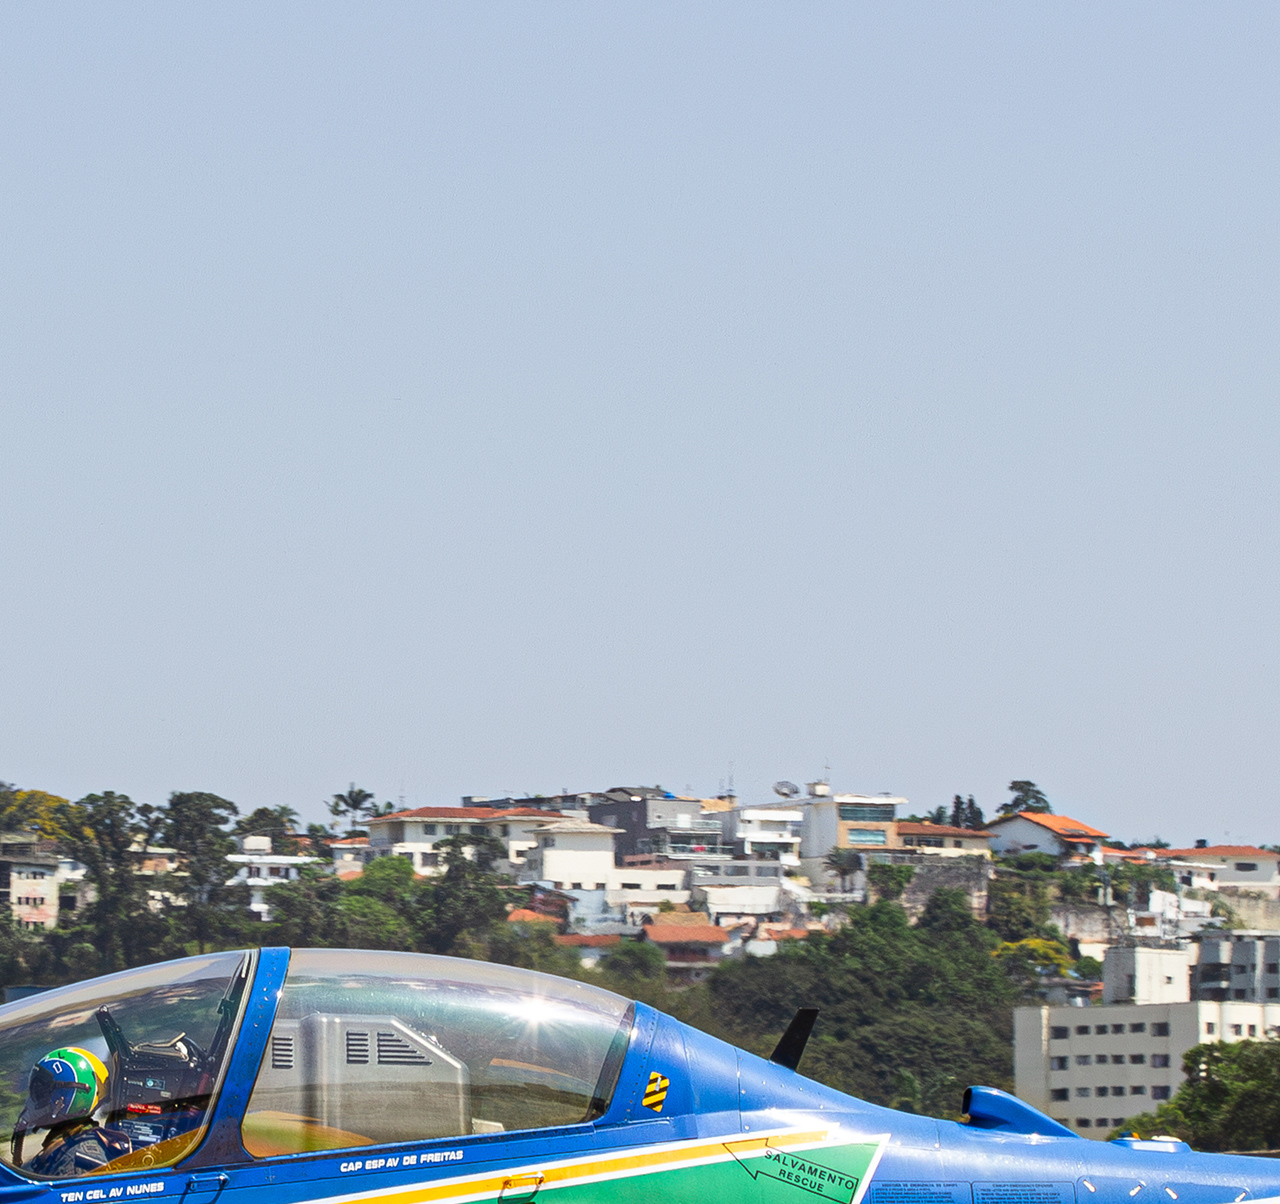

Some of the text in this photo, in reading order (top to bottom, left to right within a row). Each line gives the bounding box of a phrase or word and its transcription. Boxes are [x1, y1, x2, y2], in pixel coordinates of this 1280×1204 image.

[340, 1161, 362, 1173] CAP
[402, 1155, 417, 1166] DE
[420, 1150, 464, 1164] FREITAS
[764, 1150, 855, 1190] SALVAMENTO
[60, 1181, 165, 1203] TEN CEL AV NUNES
[778, 1168, 825, 1193] RESCUE
